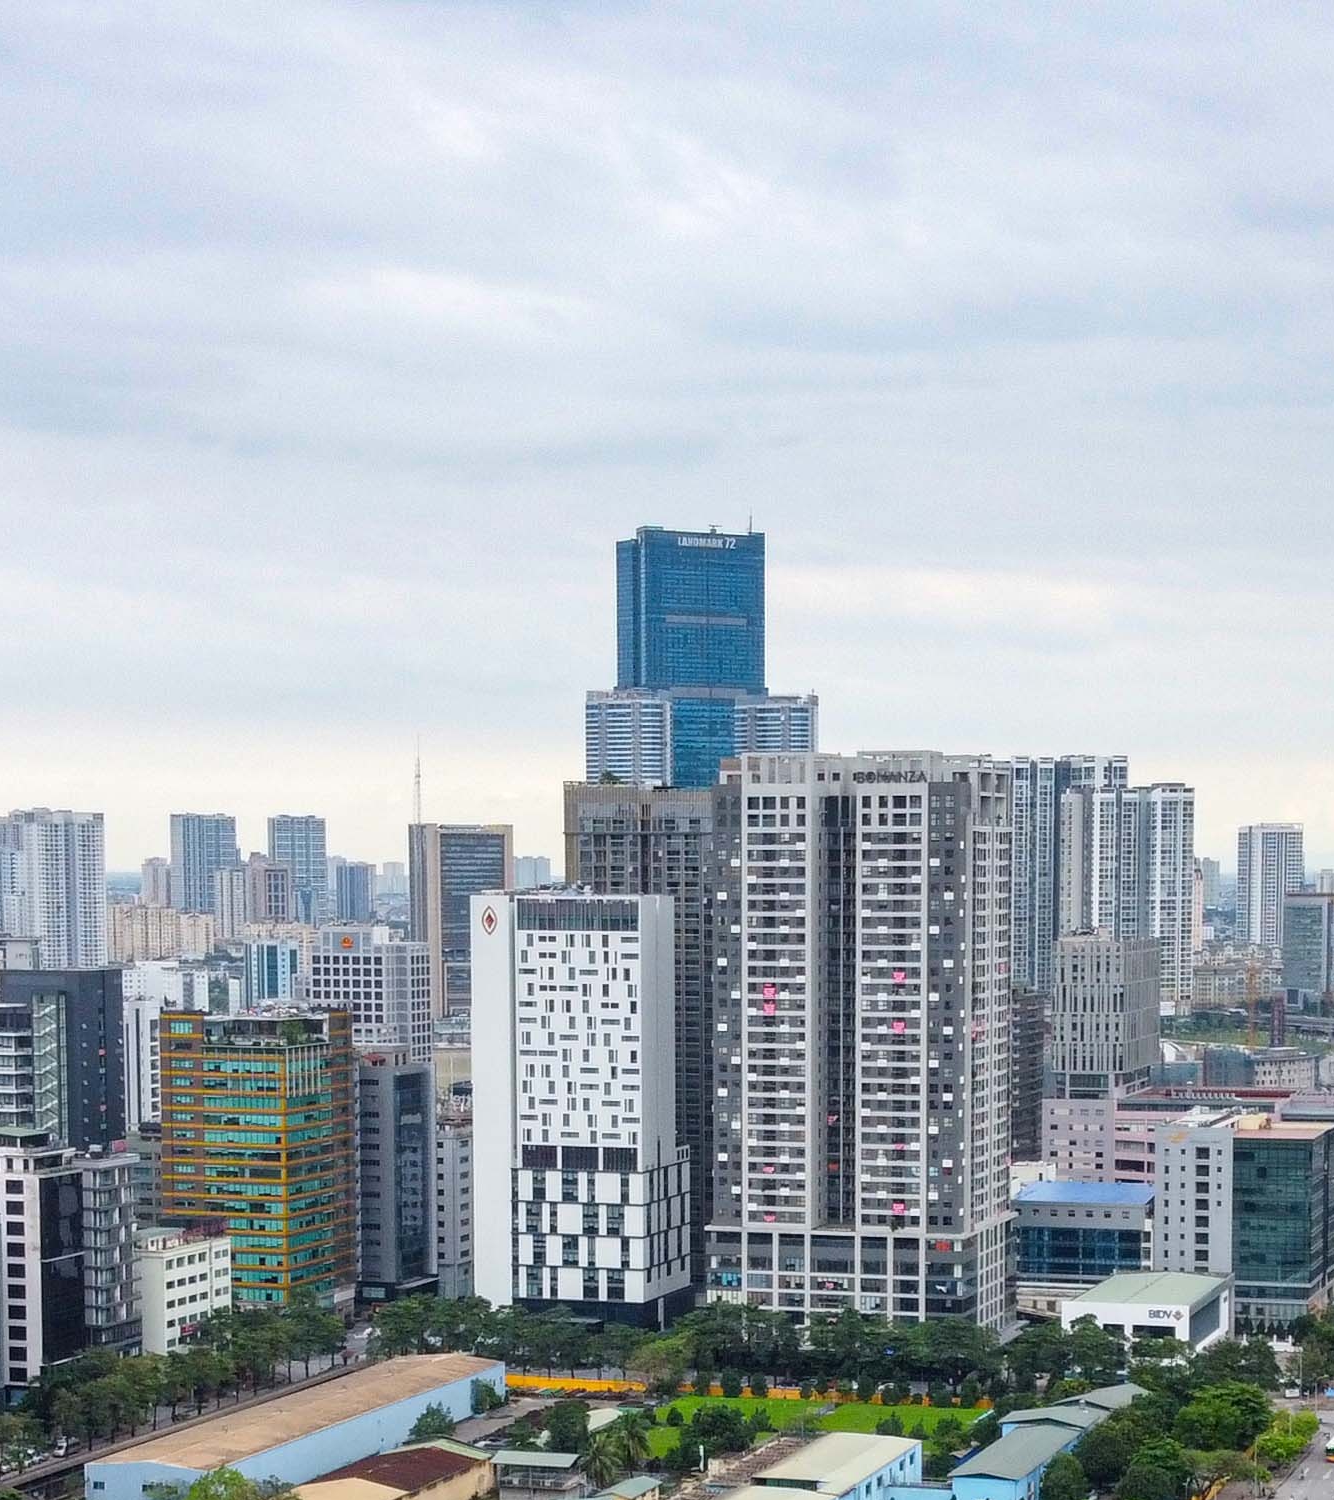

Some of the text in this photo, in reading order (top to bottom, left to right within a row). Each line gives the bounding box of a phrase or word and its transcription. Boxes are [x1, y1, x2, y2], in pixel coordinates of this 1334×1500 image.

[678, 536, 736, 549] LANDMARK 72
[856, 770, 927, 784] BONANZA
[1148, 1309, 1172, 1319] BIDV
